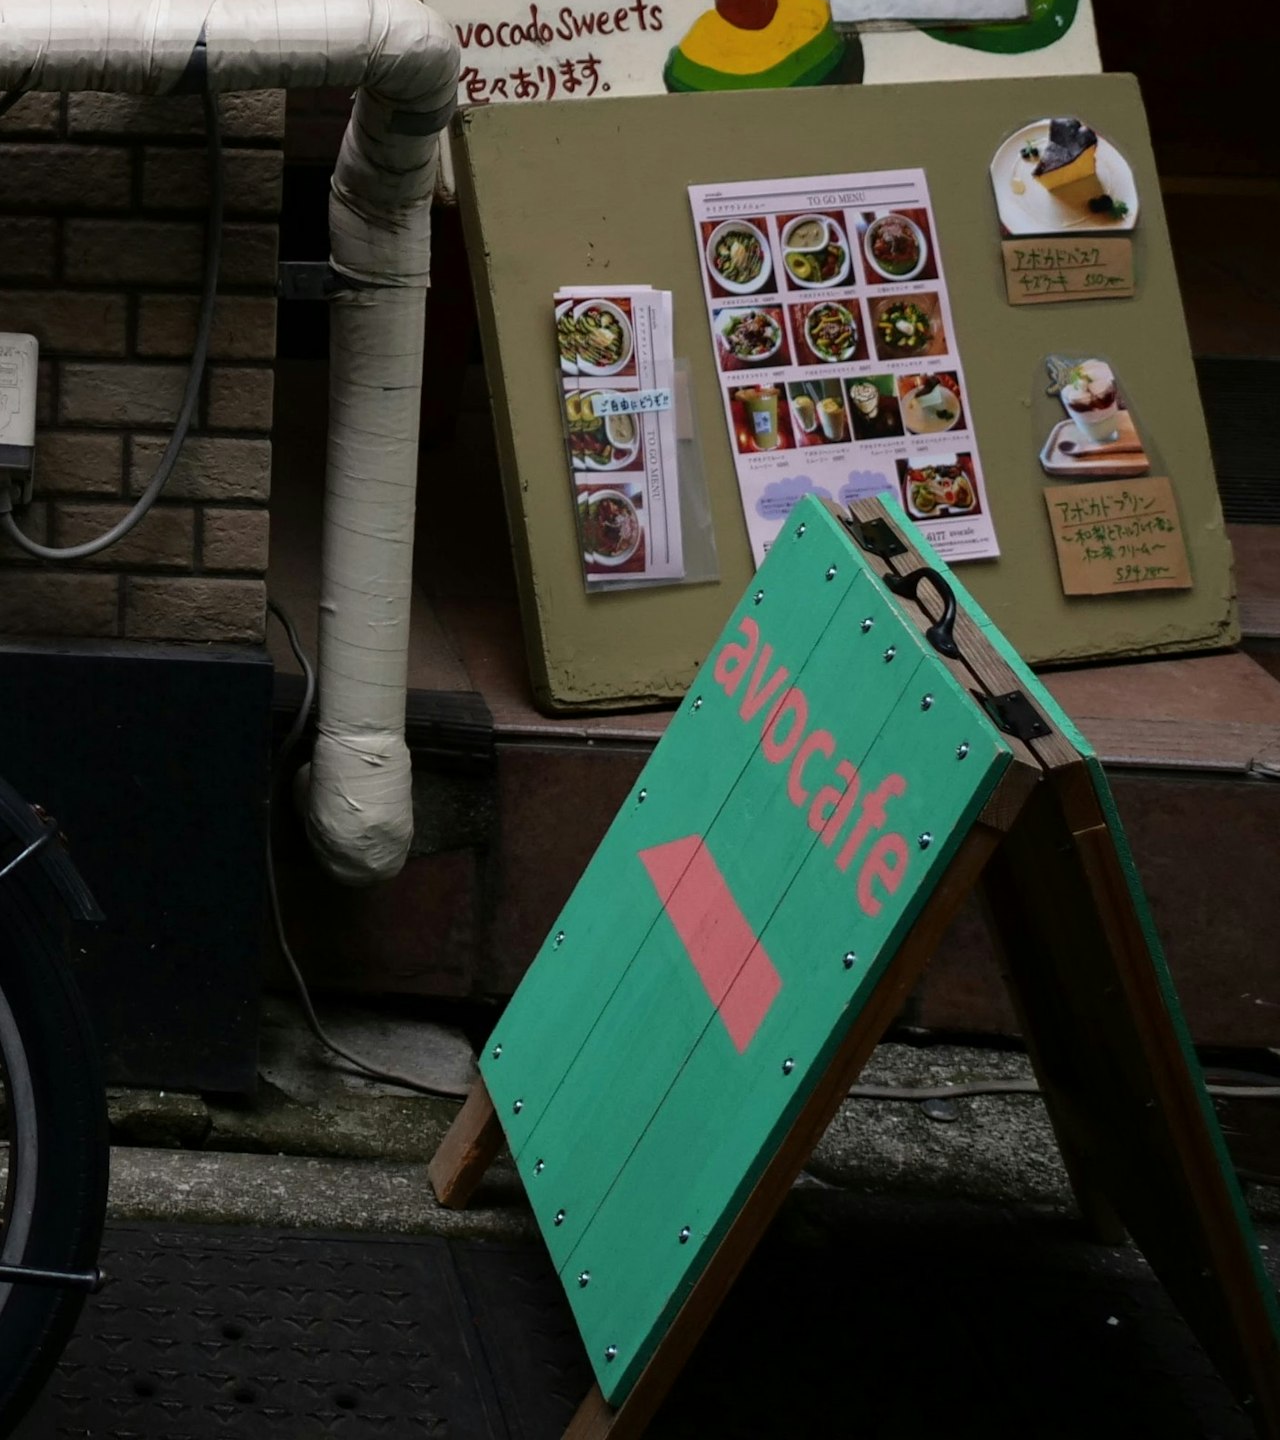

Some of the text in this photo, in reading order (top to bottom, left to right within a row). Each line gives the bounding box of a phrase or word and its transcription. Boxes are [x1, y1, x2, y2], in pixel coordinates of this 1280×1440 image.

[449, 3, 554, 49] vocado
[806, 191, 867, 207] TO GO MENU
[646, 430, 661, 502] TO GO MENU
[1055, 491, 1157, 522] アボカドプリン
[712, 614, 910, 918] avocafe
